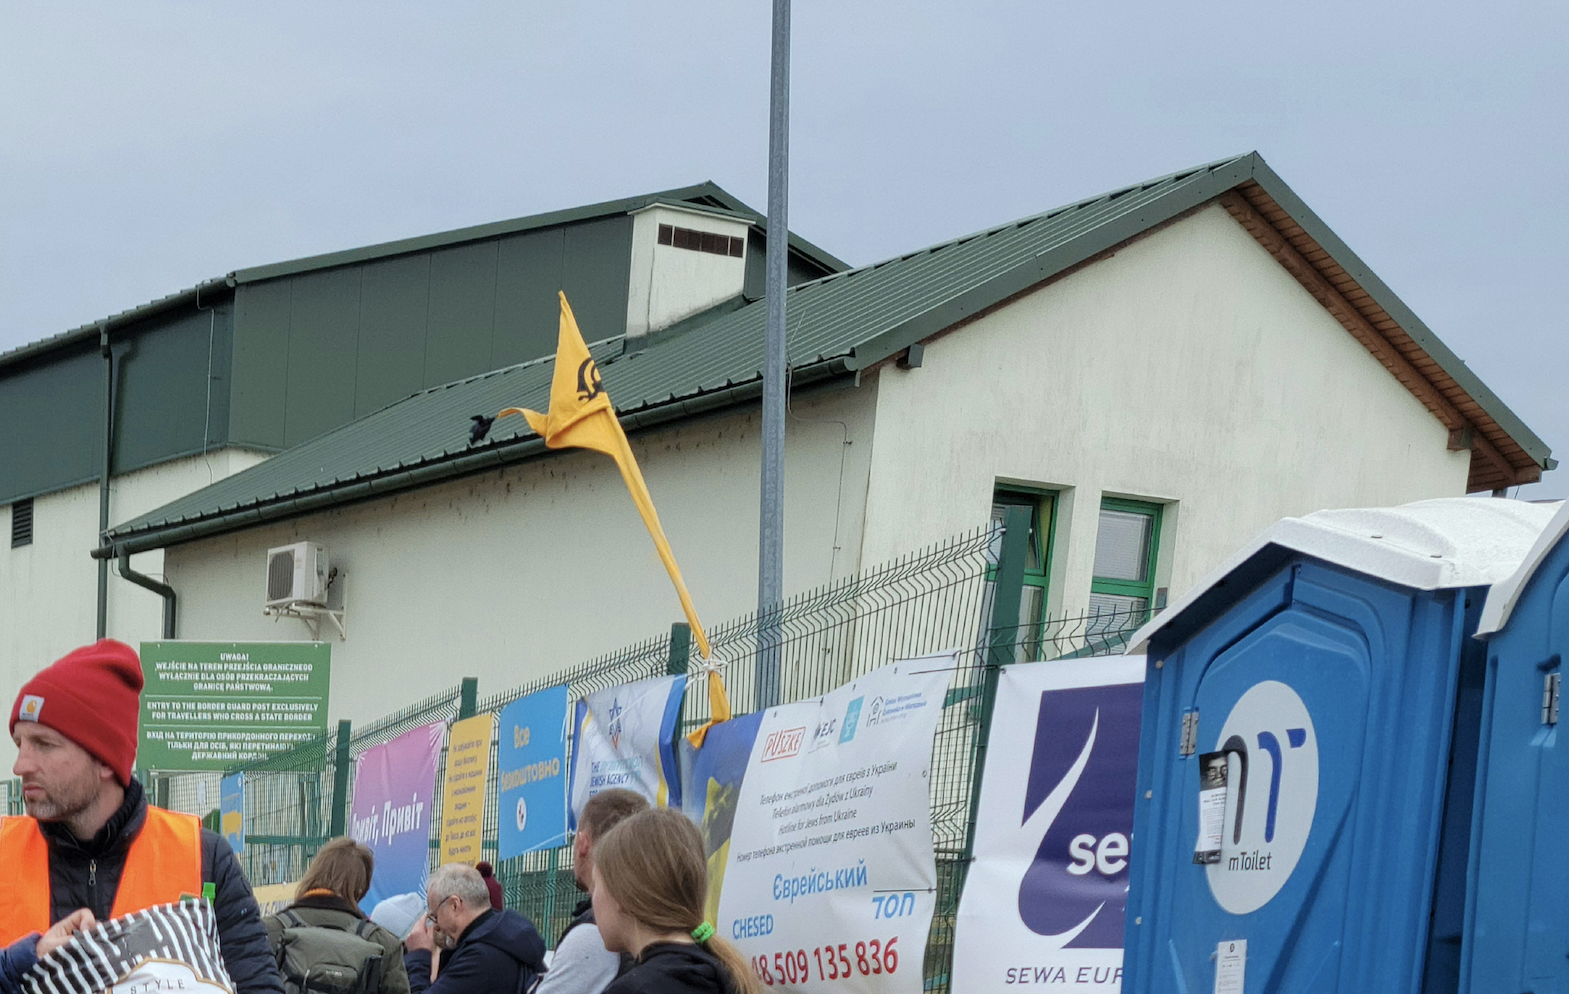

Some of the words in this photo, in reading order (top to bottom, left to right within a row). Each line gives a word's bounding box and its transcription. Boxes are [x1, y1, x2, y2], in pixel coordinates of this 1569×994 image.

[220, 652, 249, 661] UWAGA!
[156, 660, 187, 670] WEJŚCIE
[188, 662, 198, 670] NA
[200, 662, 223, 671] TEREN
[224, 661, 262, 671] PRZEJŚCIA
[263, 663, 313, 672] GRANICZNEGO
[159, 672, 200, 682] WYŁĄCZNIE
[201, 673, 215, 681] DLA
[216, 671, 235, 681] OSÓB
[236, 673, 309, 683] PRZEKRACZAJĄCYCH
[193, 682, 224, 692] GRANICĘ
[147, 702, 170, 710] ENTRY
[171, 702, 181, 710] TO
[181, 702, 196, 710] THE
[197, 702, 226, 710] BORDER
[226, 703, 251, 711] GUARD
[252, 703, 271, 711] POST
[271, 703, 318, 712] EXCLUSIVELY
[152, 711, 166, 719] FOR
[167, 711, 212, 720] TRAVELLERS
[213, 712, 230, 720] WHO
[231, 712, 253, 720] CROSS
[261, 713, 282, 721] STATE
[284, 713, 312, 721] BORDER
[146, 731, 164, 741] ВХІД
[164, 731, 175, 739] НА
[176, 731, 216, 740] ТЕРИТОРІЮ
[217, 733, 278, 742] ПРИКОРДОННОГО
[514, 725, 530, 749] Все
[167, 741, 192, 750] ТІЛЬКИ
[193, 742, 209, 751] ДЛЯ
[210, 742, 229, 752] ОСІБ,
[229, 743, 242, 751] ЯКІ
[192, 751, 238, 761] ДЕРЖАВНИЙ
[871, 761, 898, 778] України
[849, 784, 874, 799] Ukrainy
[382, 792, 424, 846] Привіт
[797, 818, 805, 831] for
[804, 816, 818, 829] Jews
[818, 813, 833, 826] from
[833, 808, 857, 823] Ukraine
[832, 831, 845, 844] для
[845, 826, 870, 841] евреев
[871, 825, 880, 835] из
[880, 819, 916, 835] Украины
[1228, 850, 1273, 871] mToilet
[773, 858, 868, 904] Єврейський
[732, 913, 775, 940] CHESED
[774, 948, 809, 985] 509
[813, 943, 852, 982] 135
[855, 935, 899, 977] 836
[1005, 966, 1067, 984] SEWA
